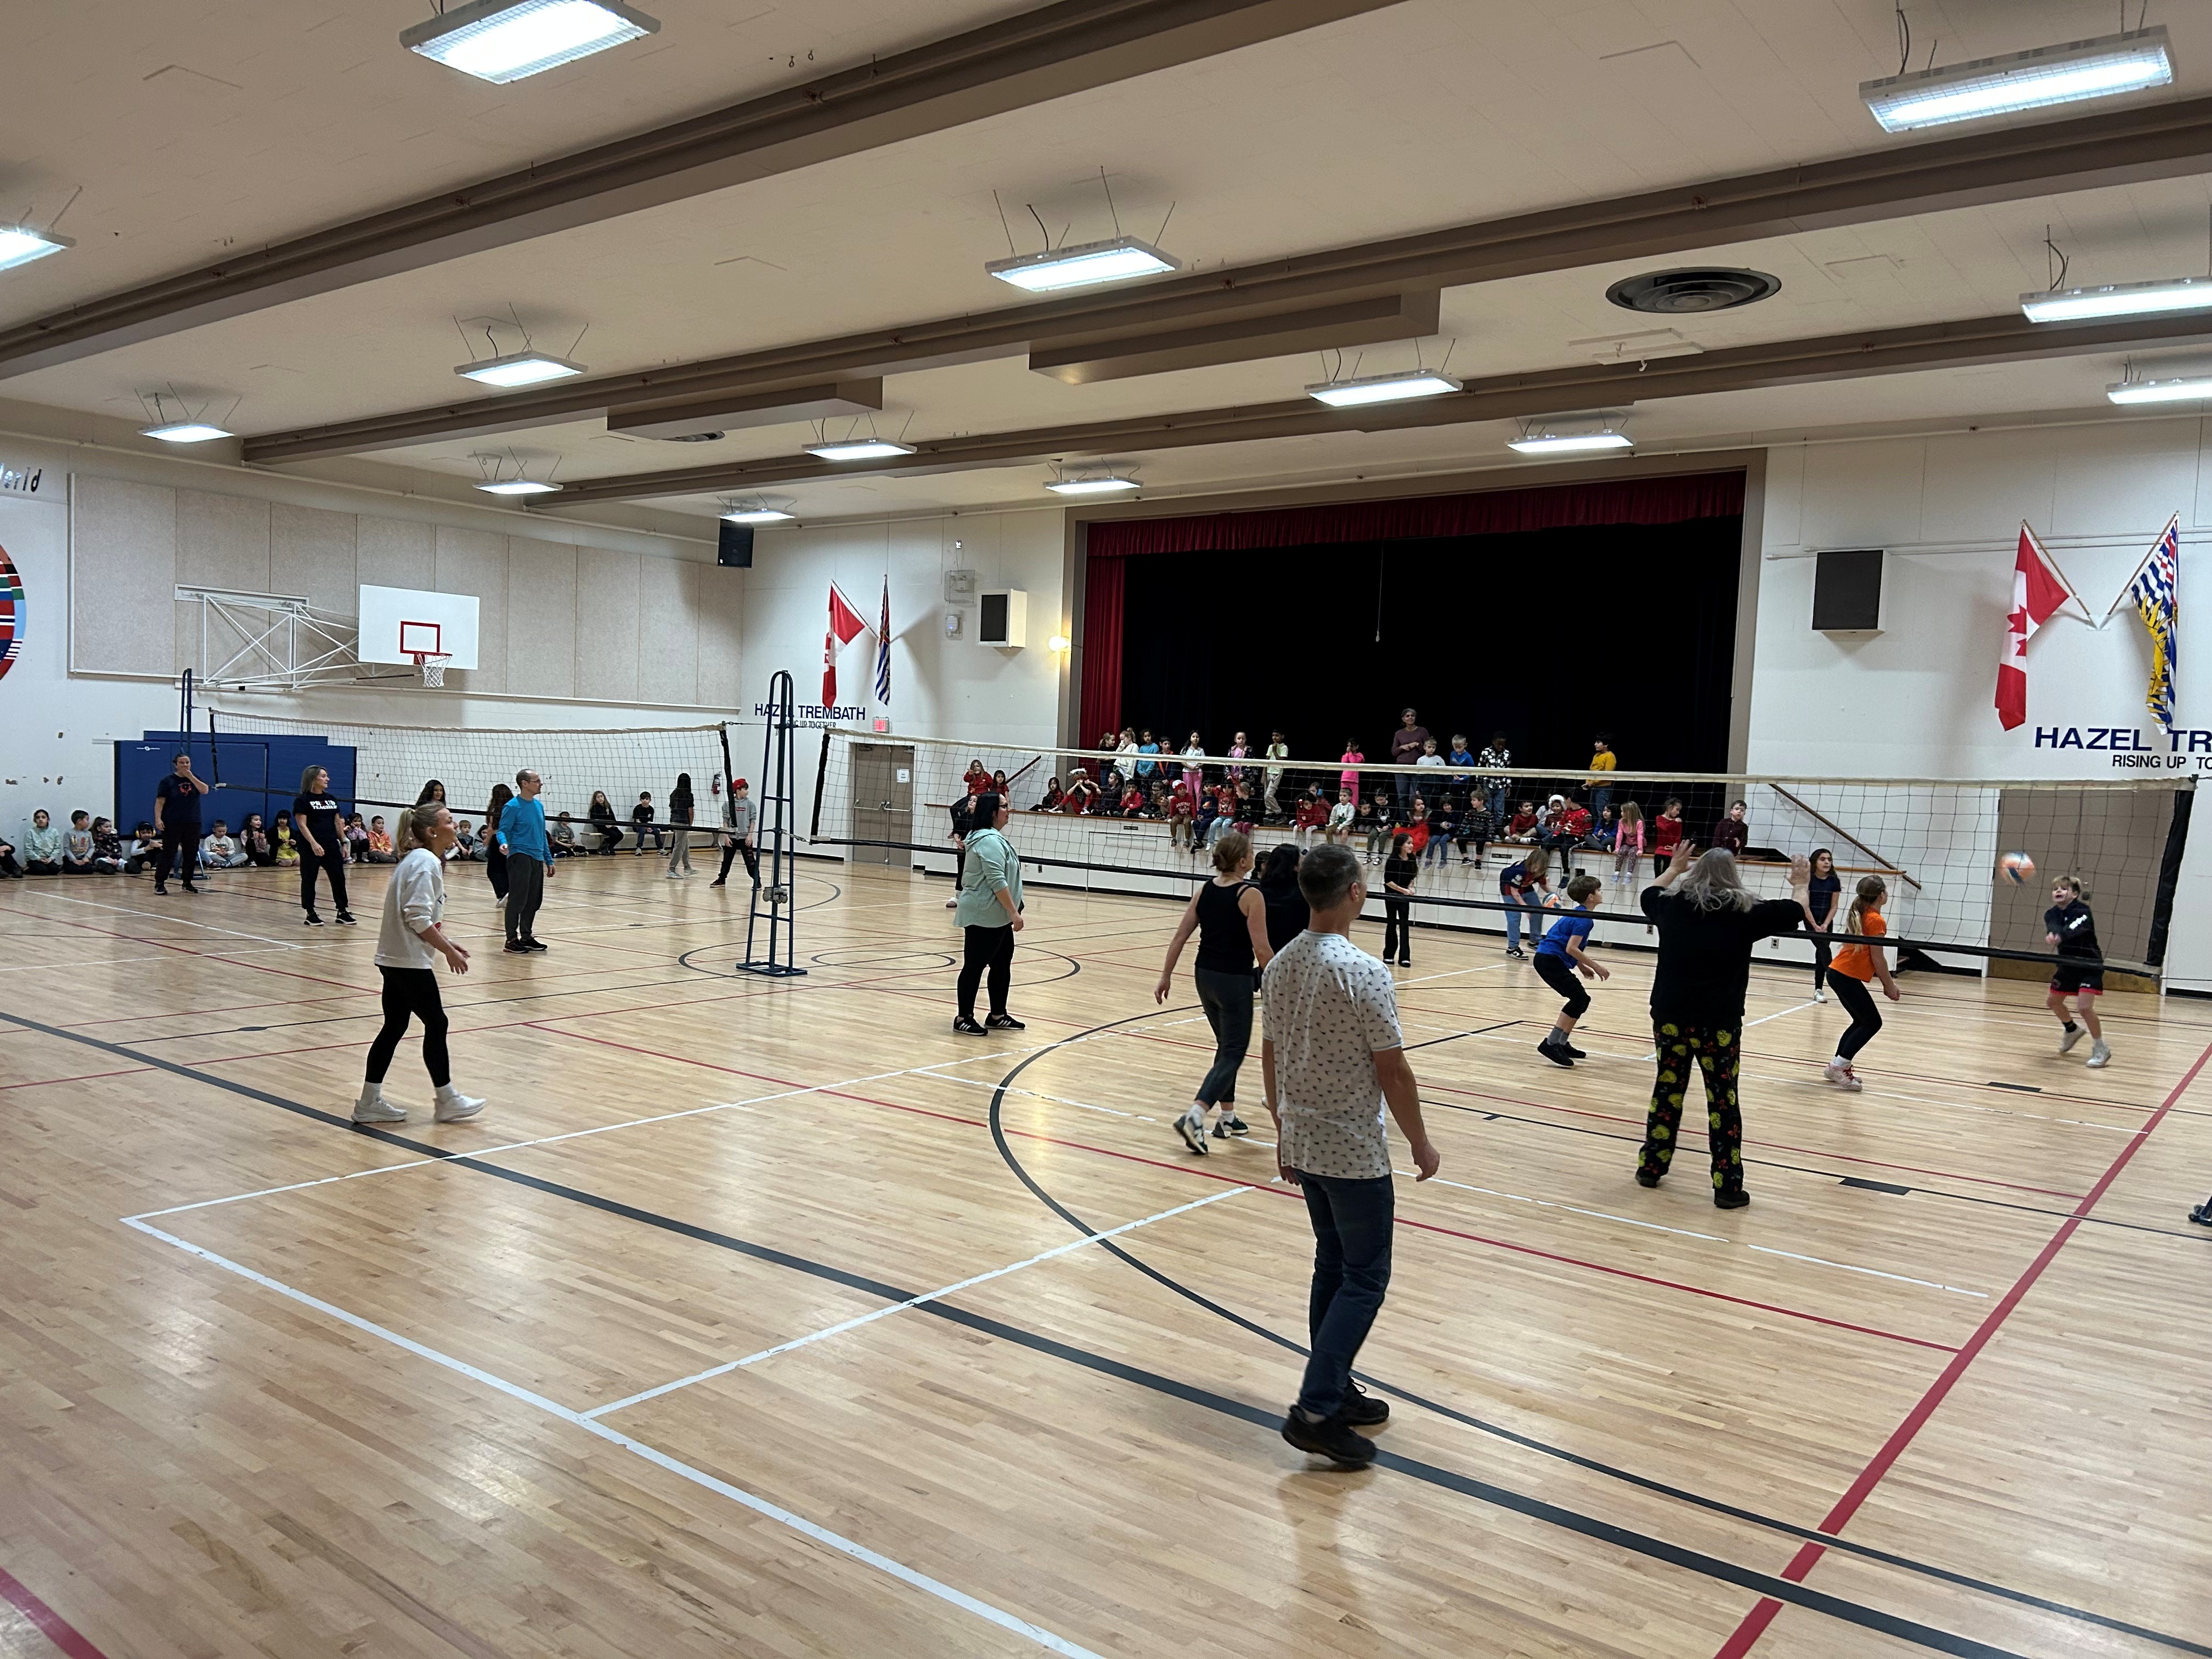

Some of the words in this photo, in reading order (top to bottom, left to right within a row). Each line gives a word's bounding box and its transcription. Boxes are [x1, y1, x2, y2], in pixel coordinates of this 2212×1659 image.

[0, 463, 42, 492] orld
[798, 705, 865, 720] TREMBATH
[2035, 727, 2152, 751] HAZEL
[2112, 754, 2160, 768] RISING
[2167, 756, 2186, 769] UP
